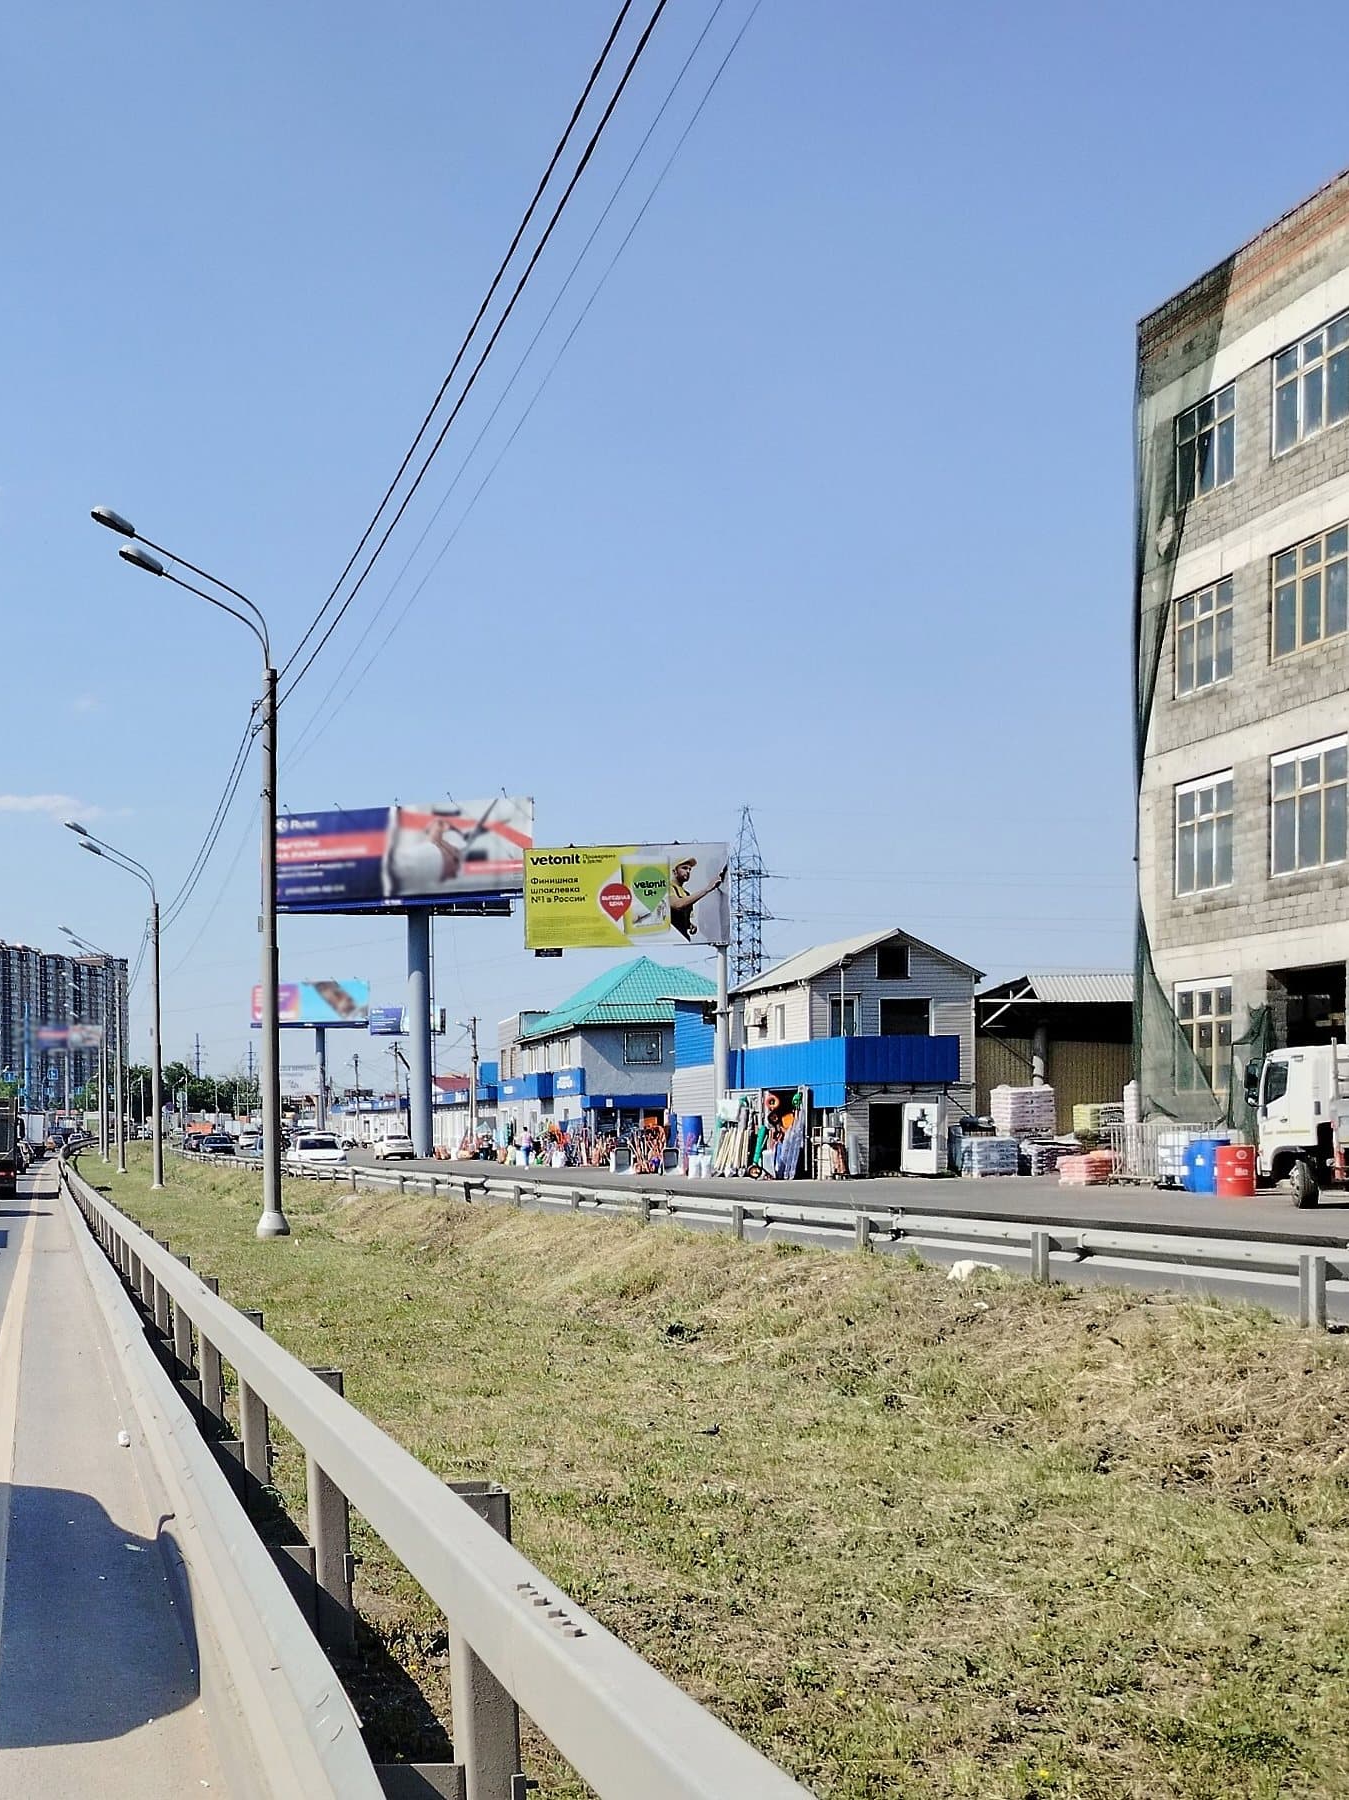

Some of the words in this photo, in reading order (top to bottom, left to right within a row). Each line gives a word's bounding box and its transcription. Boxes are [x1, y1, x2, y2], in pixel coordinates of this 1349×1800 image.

[530, 854, 581, 866] vetonit
[530, 877, 579, 885] Финишная
[530, 886, 580, 895] шпаклевка
[531, 896, 545, 904] №1
